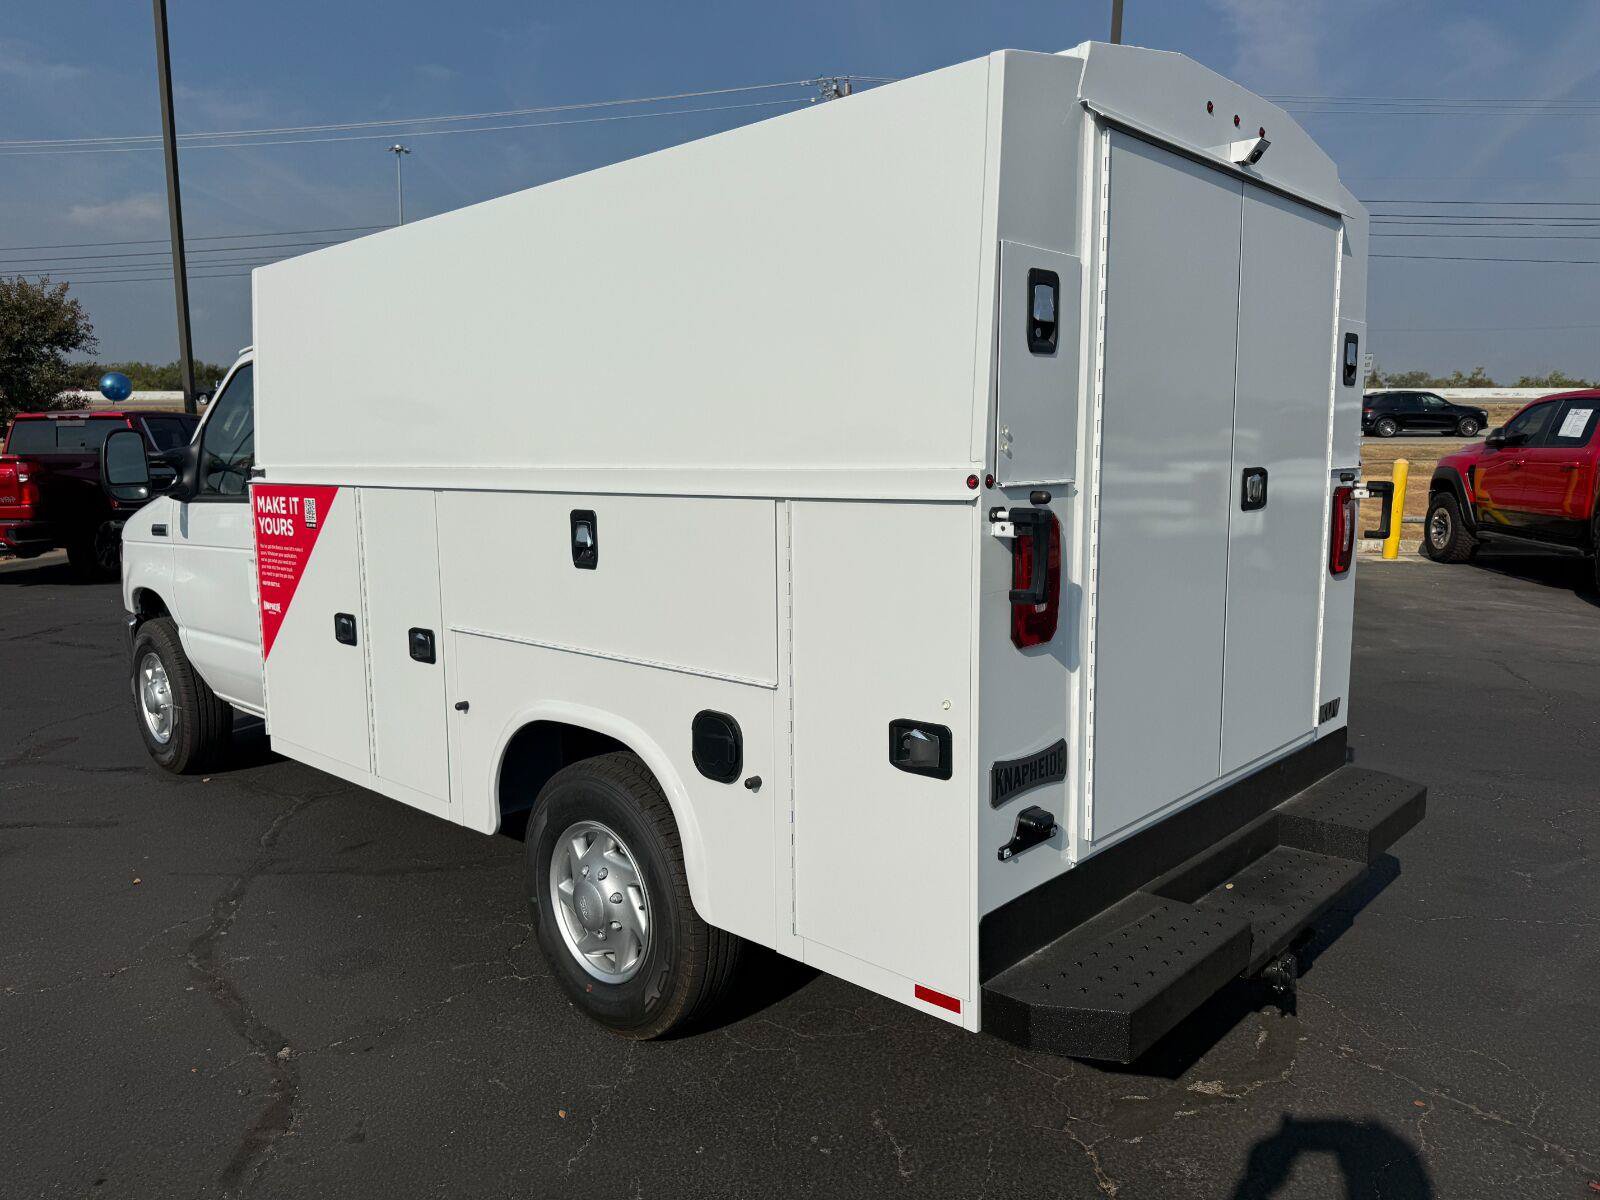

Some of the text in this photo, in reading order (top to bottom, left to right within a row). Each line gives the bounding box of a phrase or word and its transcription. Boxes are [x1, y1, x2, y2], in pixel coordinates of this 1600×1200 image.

[257, 496, 299, 515] MAKE IT
[258, 517, 294, 537] YOURS
[994, 743, 1065, 801] KNAPHEIDE
